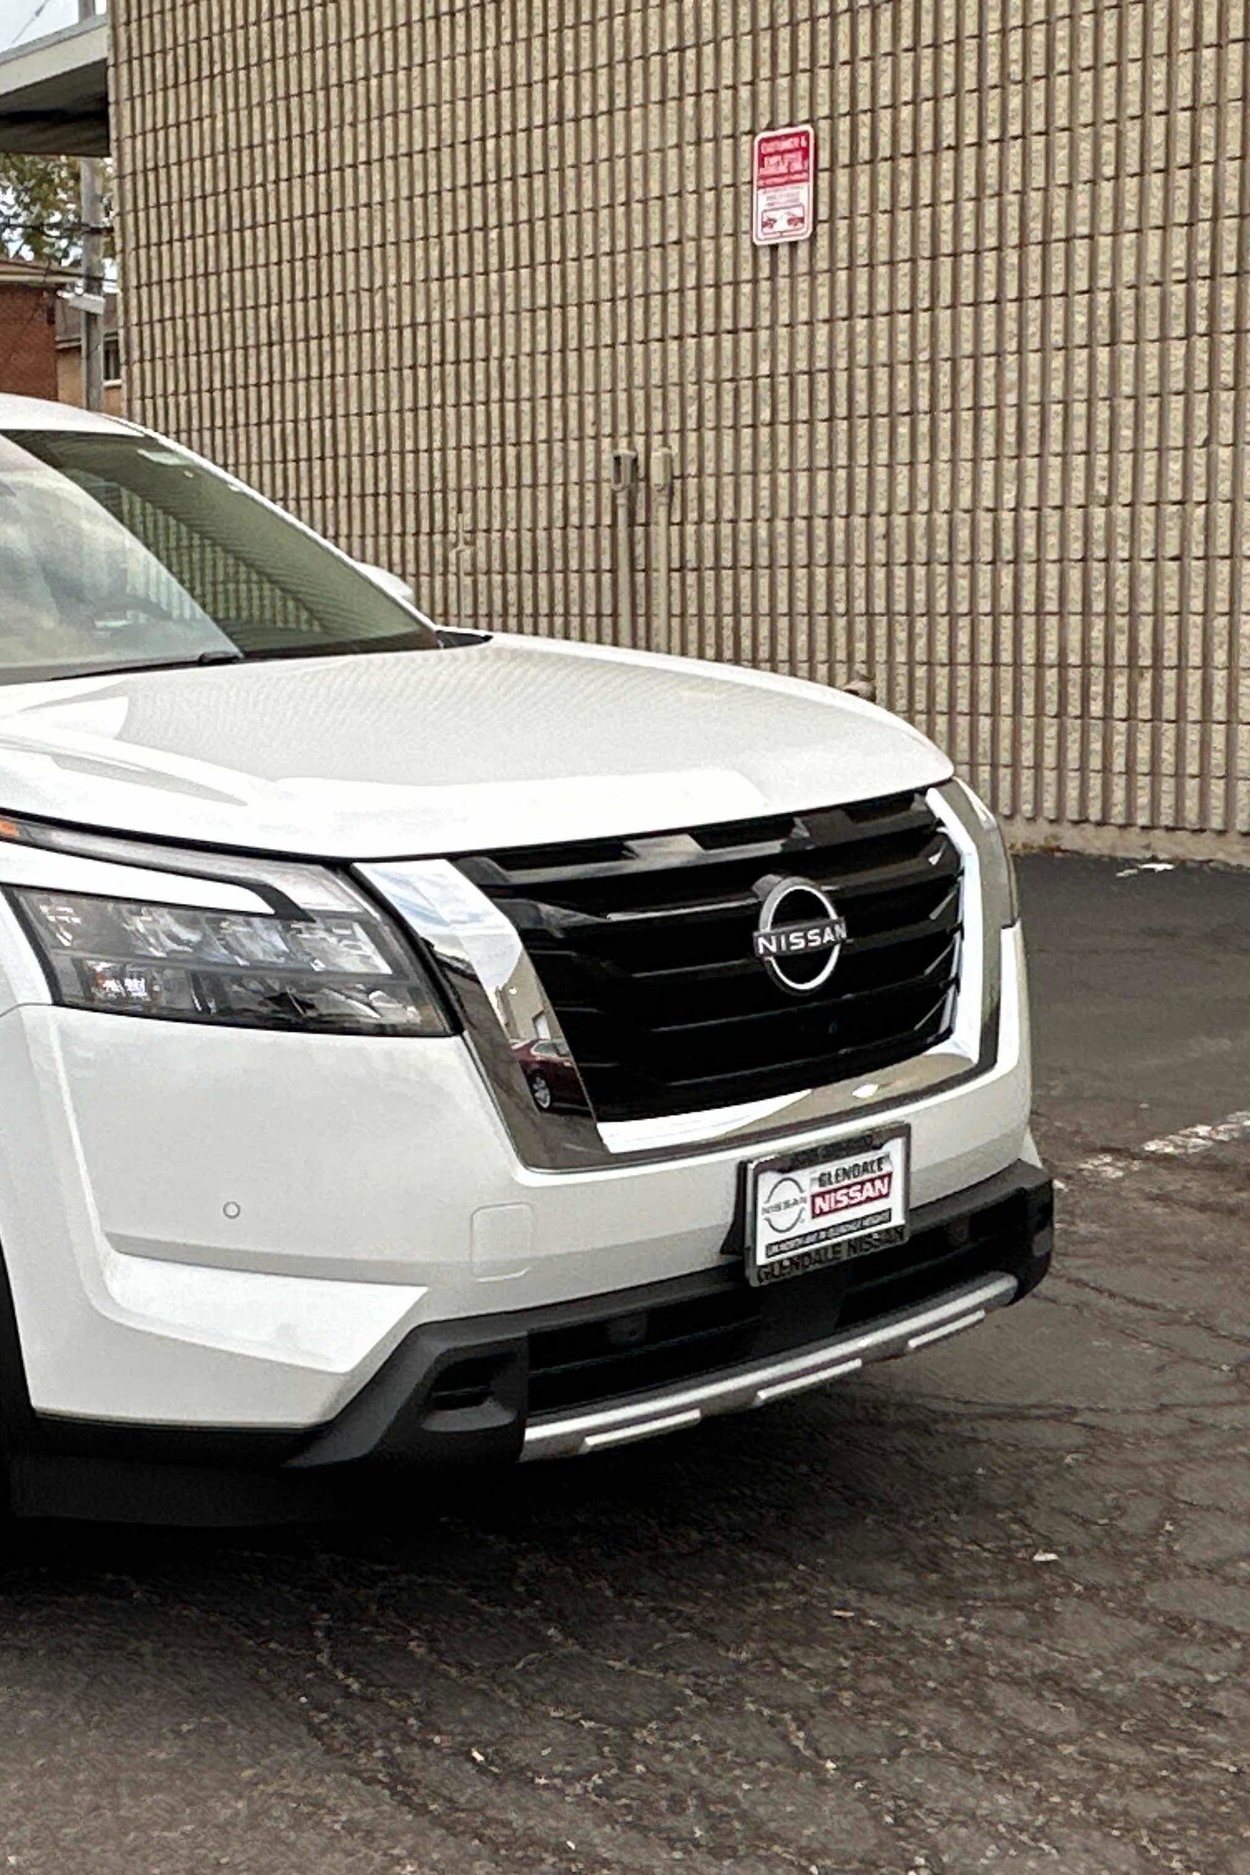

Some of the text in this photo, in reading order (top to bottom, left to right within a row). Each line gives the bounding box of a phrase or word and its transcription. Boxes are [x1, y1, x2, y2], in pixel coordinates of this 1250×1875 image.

[758, 924, 847, 954] NISSAN
[818, 1157, 884, 1188] GLENDALE
[761, 1196, 807, 1216] NISSAN
[813, 1176, 889, 1215] NISSAN
[757, 1227, 905, 1283] GLENDALE NISSAN
